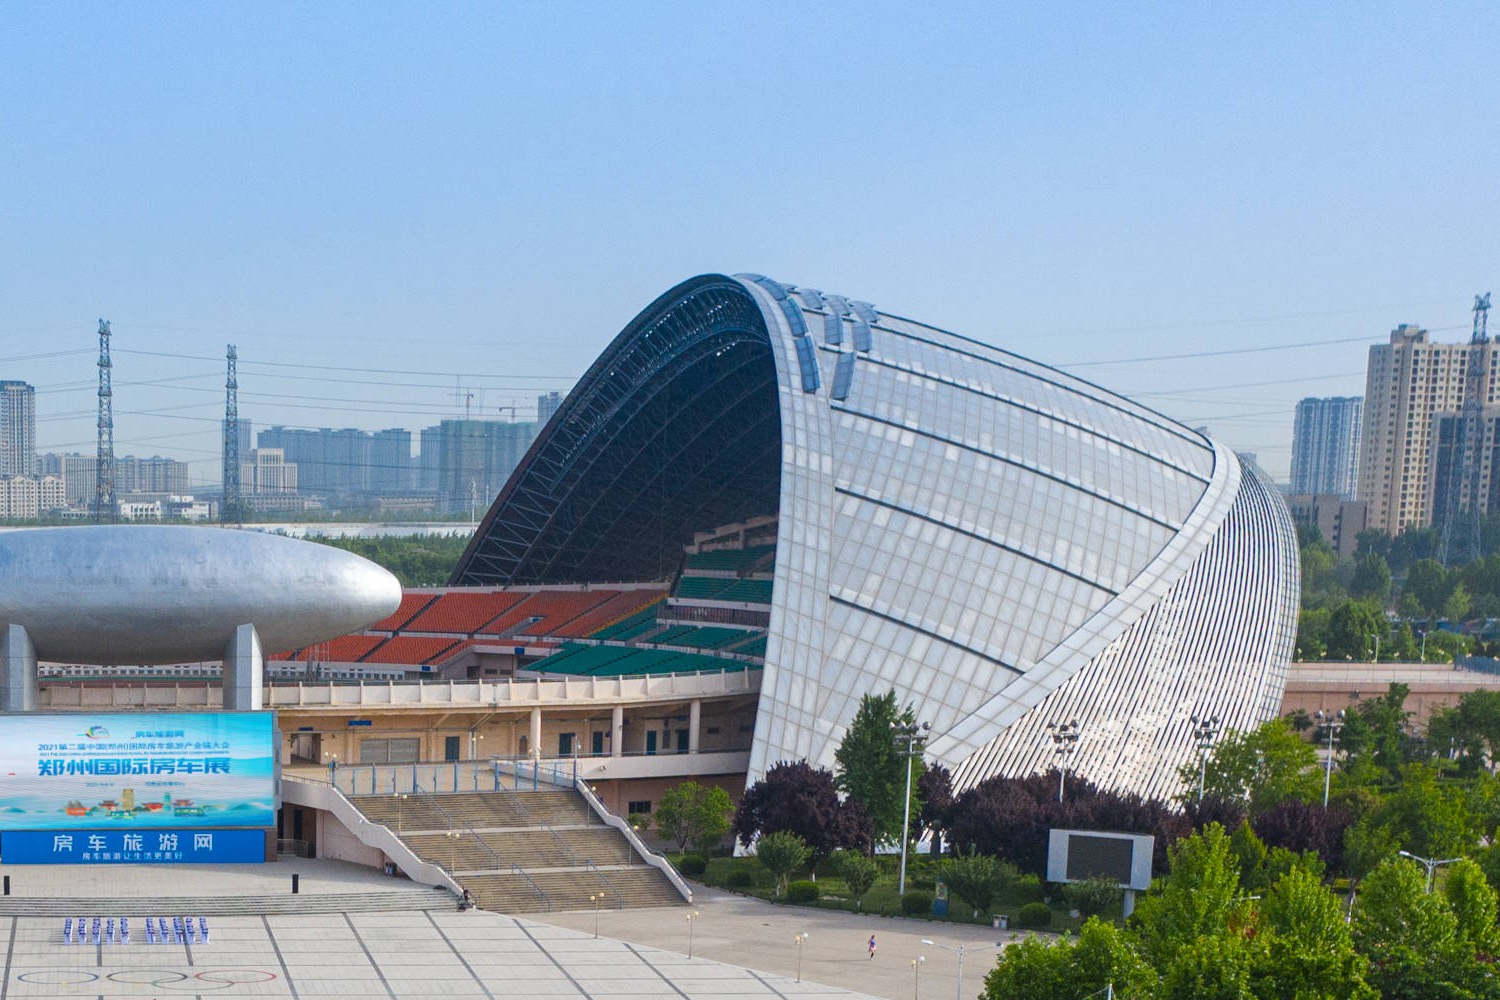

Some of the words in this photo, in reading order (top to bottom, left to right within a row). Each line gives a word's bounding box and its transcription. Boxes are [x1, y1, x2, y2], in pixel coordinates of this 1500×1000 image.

[38, 757, 231, 776] 郑州国际房车展
[53, 833, 214, 852] 房车旅游网
[82, 852, 183, 861] 房车旅游让生活更美好
